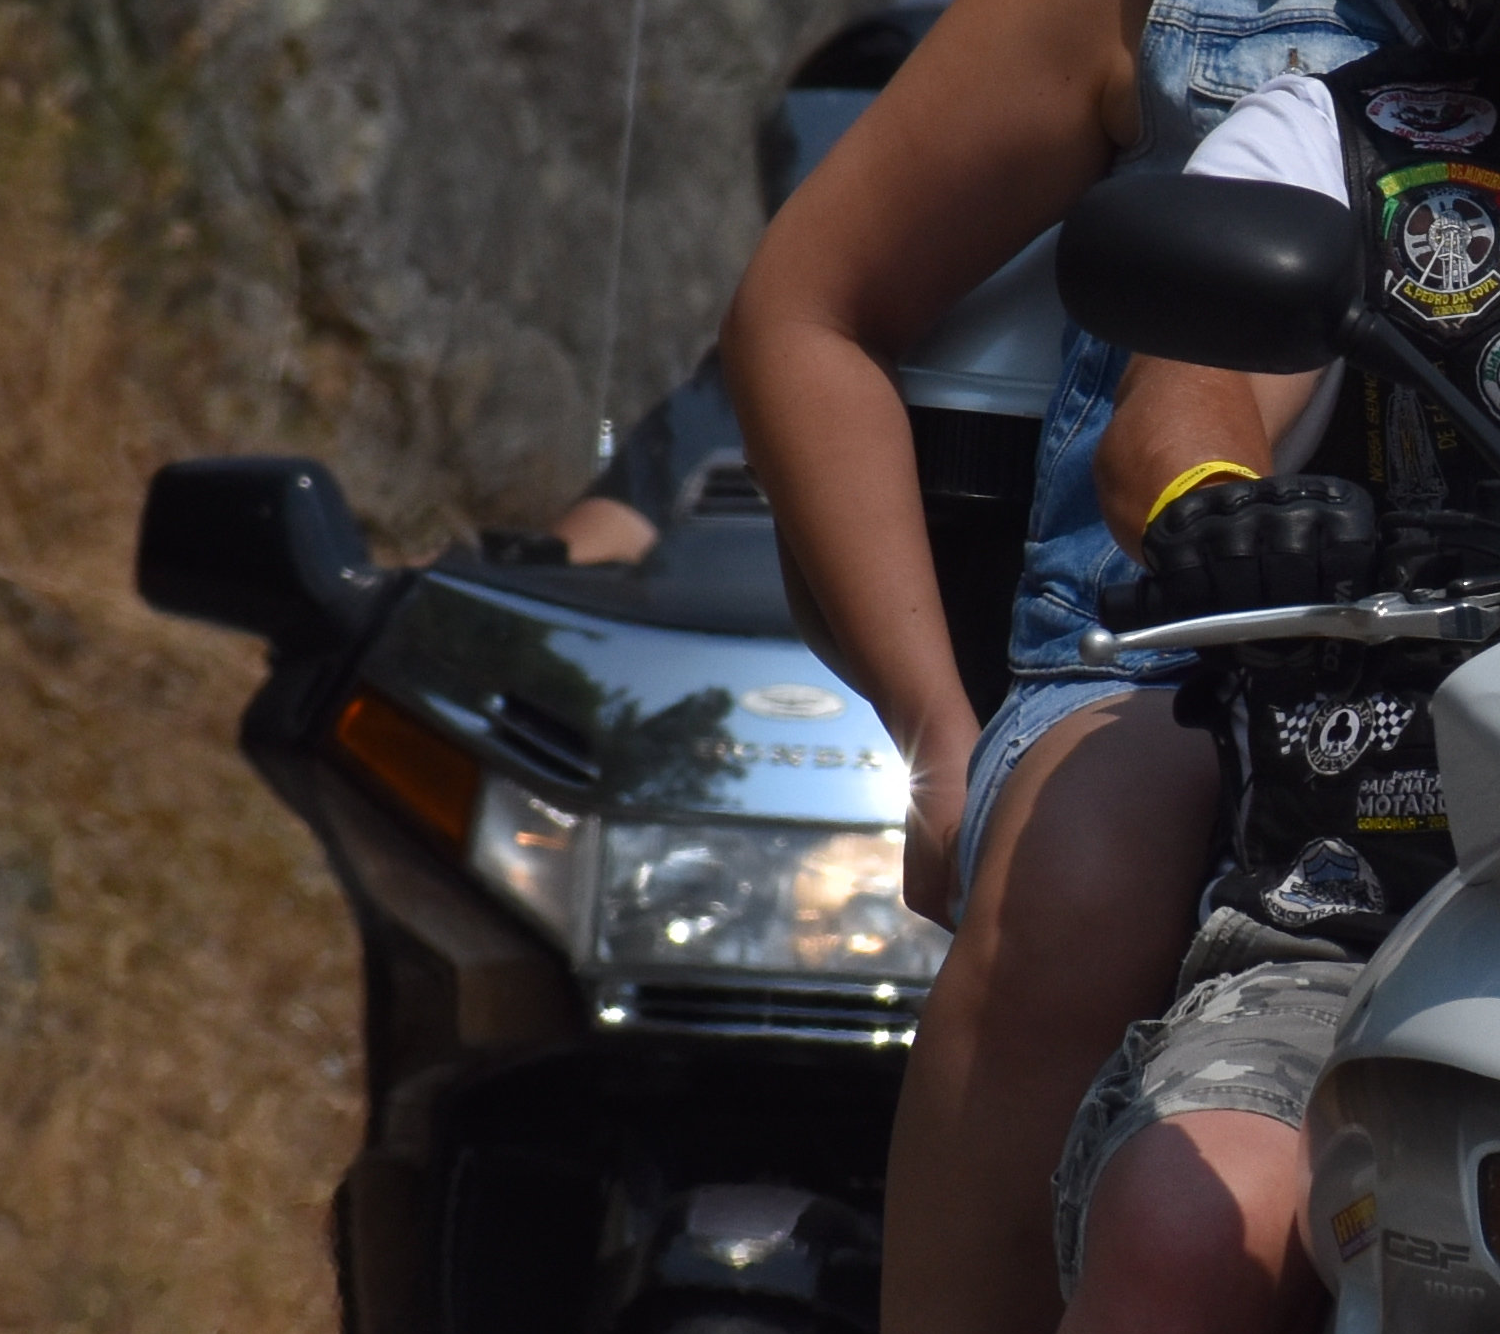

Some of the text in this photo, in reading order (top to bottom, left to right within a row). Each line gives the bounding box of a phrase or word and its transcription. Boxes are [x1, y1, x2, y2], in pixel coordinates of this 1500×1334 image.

[1412, 285, 1450, 305] PEDRO
[1451, 292, 1468, 305] DA
[1398, 774, 1443, 794] NATA
